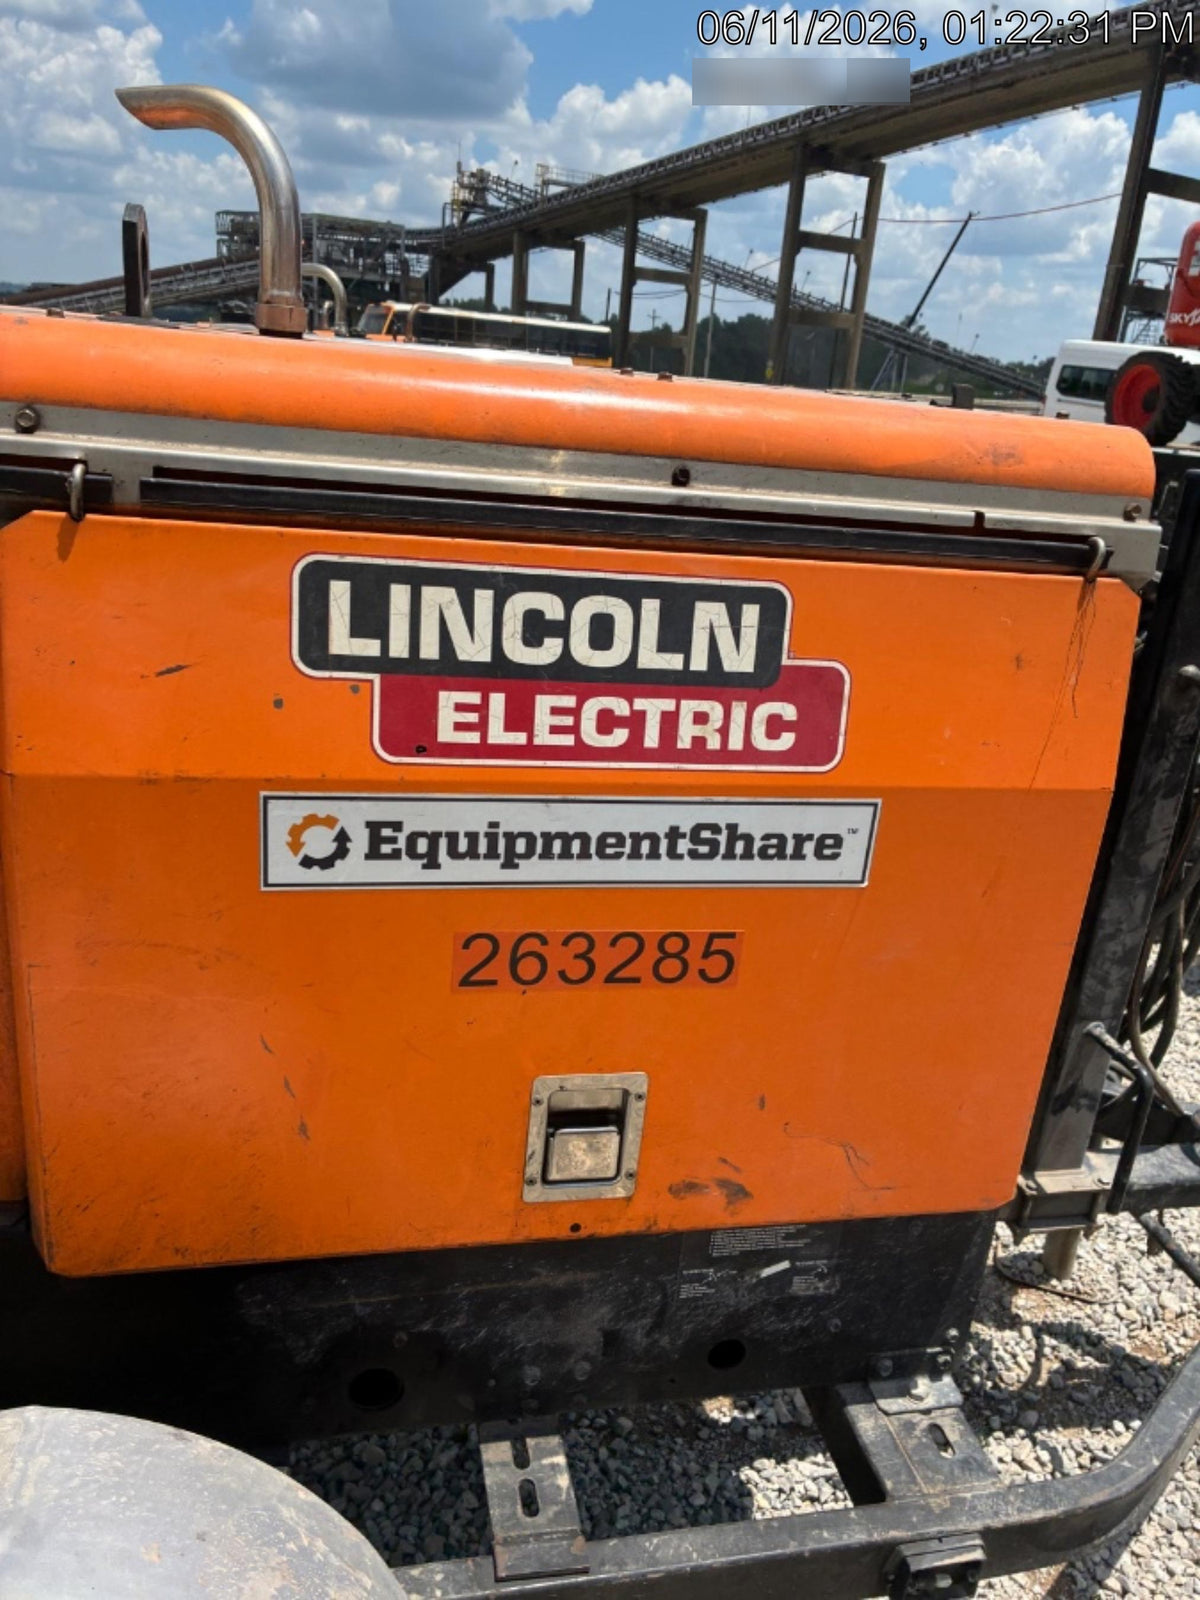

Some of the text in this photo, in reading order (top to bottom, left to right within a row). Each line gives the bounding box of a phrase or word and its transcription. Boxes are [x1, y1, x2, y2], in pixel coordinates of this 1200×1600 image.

[328, 580, 761, 673] LINCOLN
[436, 690, 798, 752] ELECTRIC
[458, 930, 737, 988] 263285
